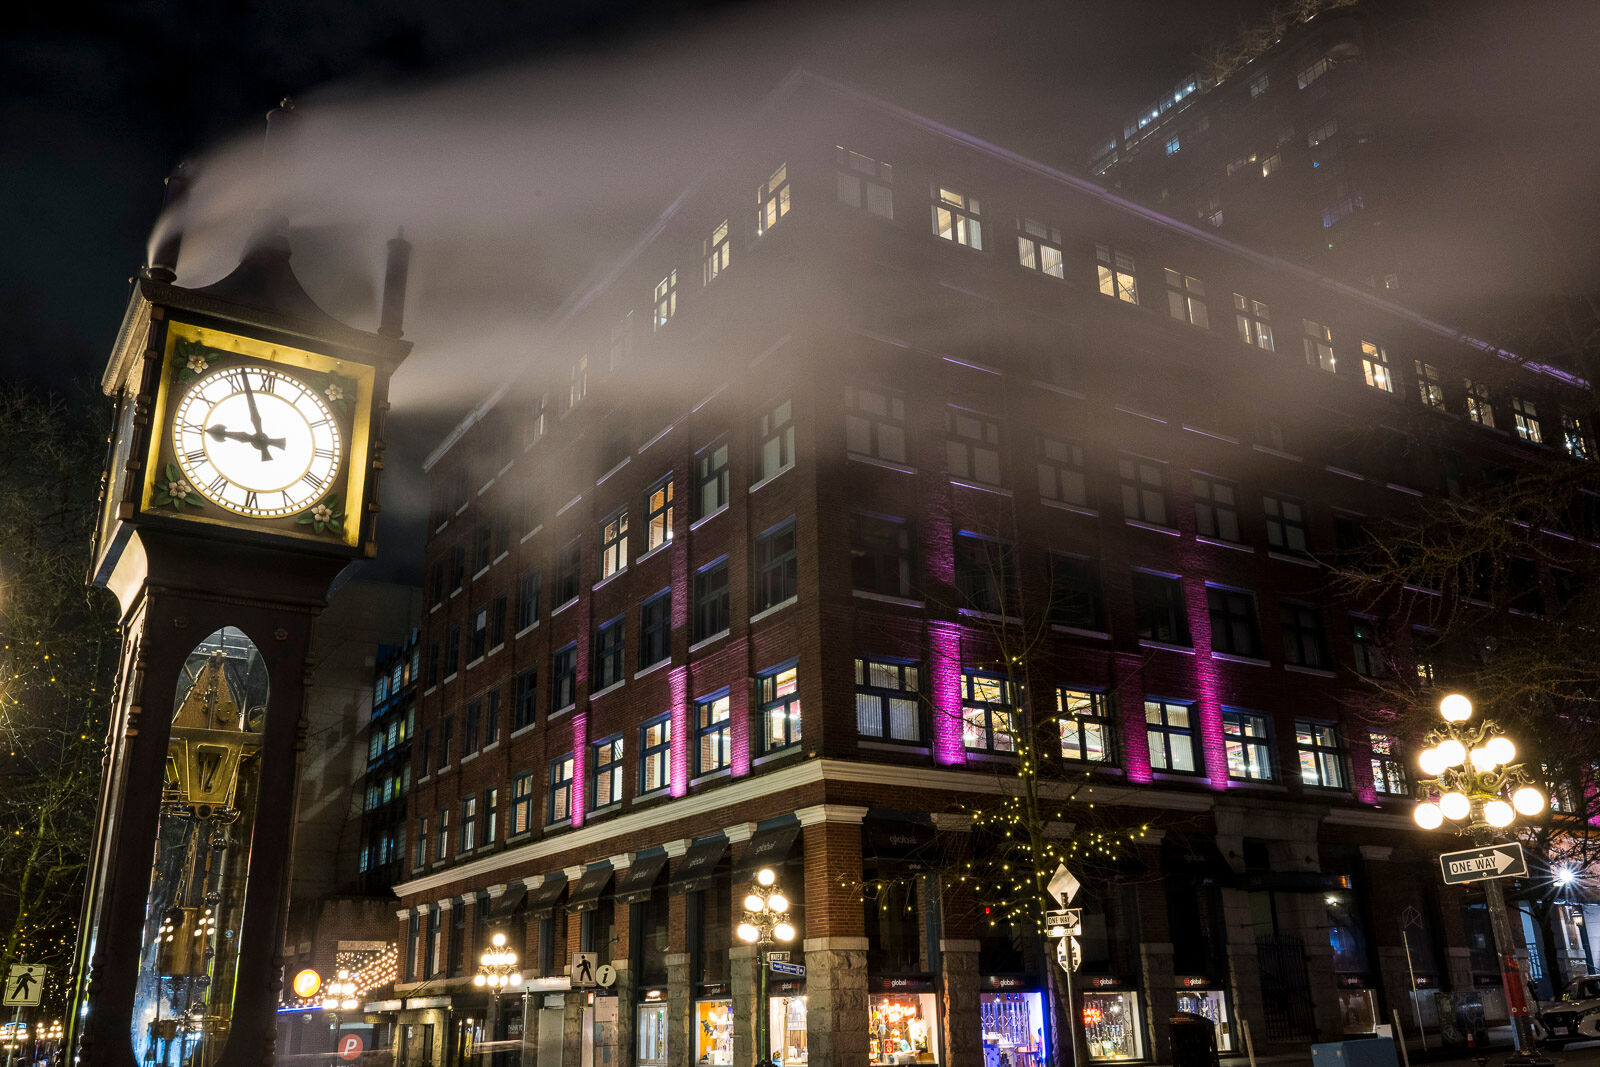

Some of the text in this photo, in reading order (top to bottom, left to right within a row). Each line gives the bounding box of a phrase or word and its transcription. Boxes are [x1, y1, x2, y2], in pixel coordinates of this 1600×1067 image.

[260, 374, 276, 393] XII
[196, 391, 217, 409] X
[183, 420, 203, 435] IX
[311, 419, 328, 428] II
[186, 449, 209, 470] VIII
[315, 447, 334, 459] III
[208, 474, 228, 496] VII
[245, 491, 258, 509] VI
[282, 490, 296, 507] V
[1451, 857, 1496, 874] ONE WAY
[1048, 916, 1071, 925] ONE WAY
[299, 973, 316, 993] P
[891, 979, 907, 988] global
[1000, 979, 1014, 988] global
[1099, 978, 1113, 986] global
[1190, 978, 1202, 986] global
[344, 1038, 357, 1056] P
